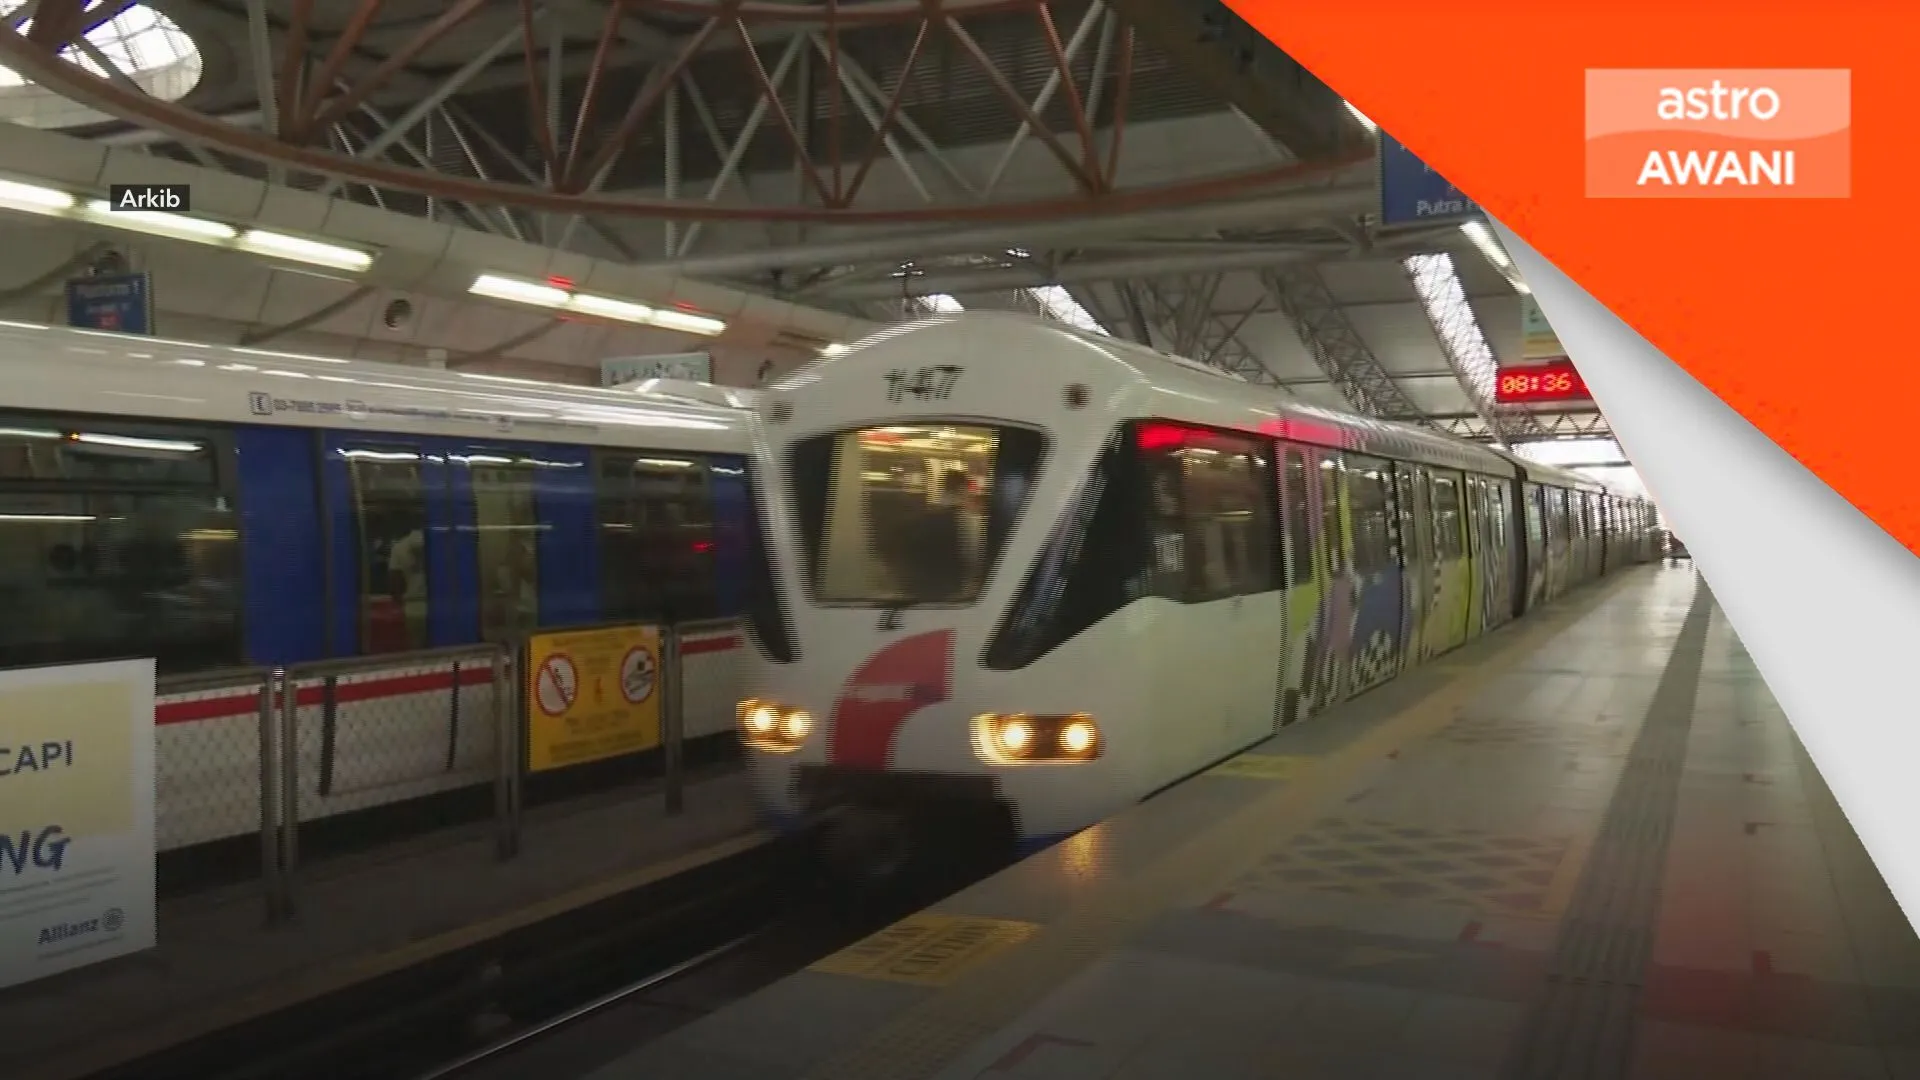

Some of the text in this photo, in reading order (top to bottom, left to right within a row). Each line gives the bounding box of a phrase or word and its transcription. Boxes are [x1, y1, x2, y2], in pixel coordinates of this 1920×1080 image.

[1416, 200, 1463, 216] Putra
[882, 364, 966, 405] 147
[1502, 373, 1572, 394] 08:36
[38, 918, 99, 945] Allianz
